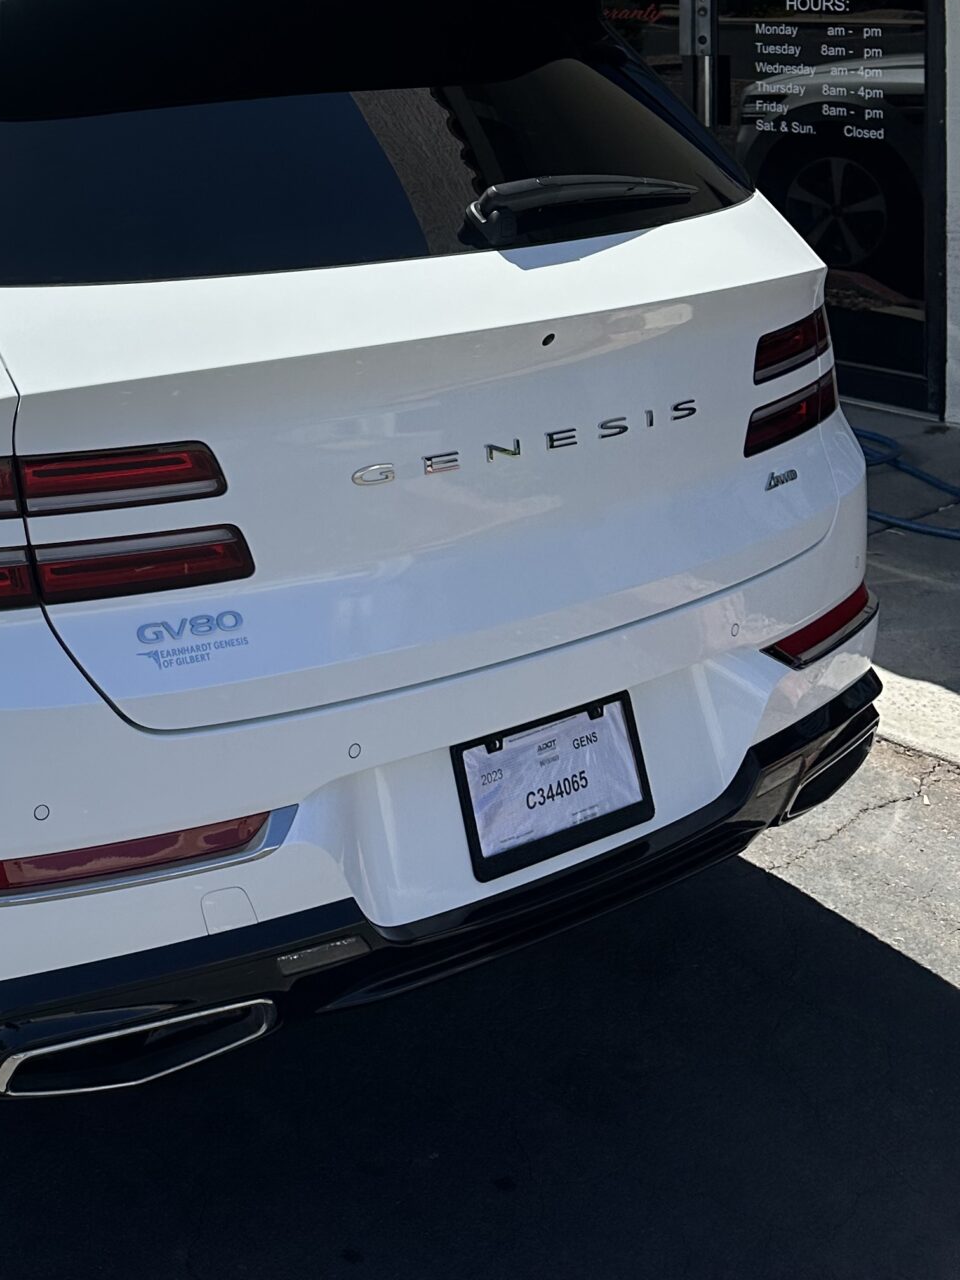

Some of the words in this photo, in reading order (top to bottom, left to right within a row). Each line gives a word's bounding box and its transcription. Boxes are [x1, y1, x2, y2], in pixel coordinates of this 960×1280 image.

[755, 23, 798, 37] Monday
[827, 26, 845, 36] am
[863, 27, 882, 39] pm
[755, 42, 801, 57] Tuesday
[820, 44, 846, 56] 8am
[864, 48, 883, 58] pm
[755, 62, 816, 77] Wednesday
[830, 66, 848, 76] am
[857, 66, 883, 79] 4pm
[755, 81, 806, 96] Thursday
[822, 84, 847, 96] 8am
[857, 86, 884, 100] 4pm
[755, 100, 789, 115] Friday
[822, 104, 847, 116] 8am
[865, 109, 884, 120] pm
[755, 120, 777, 132] Sat.
[780, 121, 788, 132] &
[791, 122, 817, 134] Sun.
[843, 125, 884, 139] Closed
[351, 399, 697, 487] GENESIS
[136, 610, 244, 645] GV80
[160, 641, 212, 658] EARNHARDT
[213, 636, 249, 650] GENESIS
[162, 658, 175, 669] OF
[175, 652, 211, 666] GILBERT
[572, 731, 599, 750] GENS
[480, 768, 504, 786] 2023
[525, 770, 589, 810] C344065
